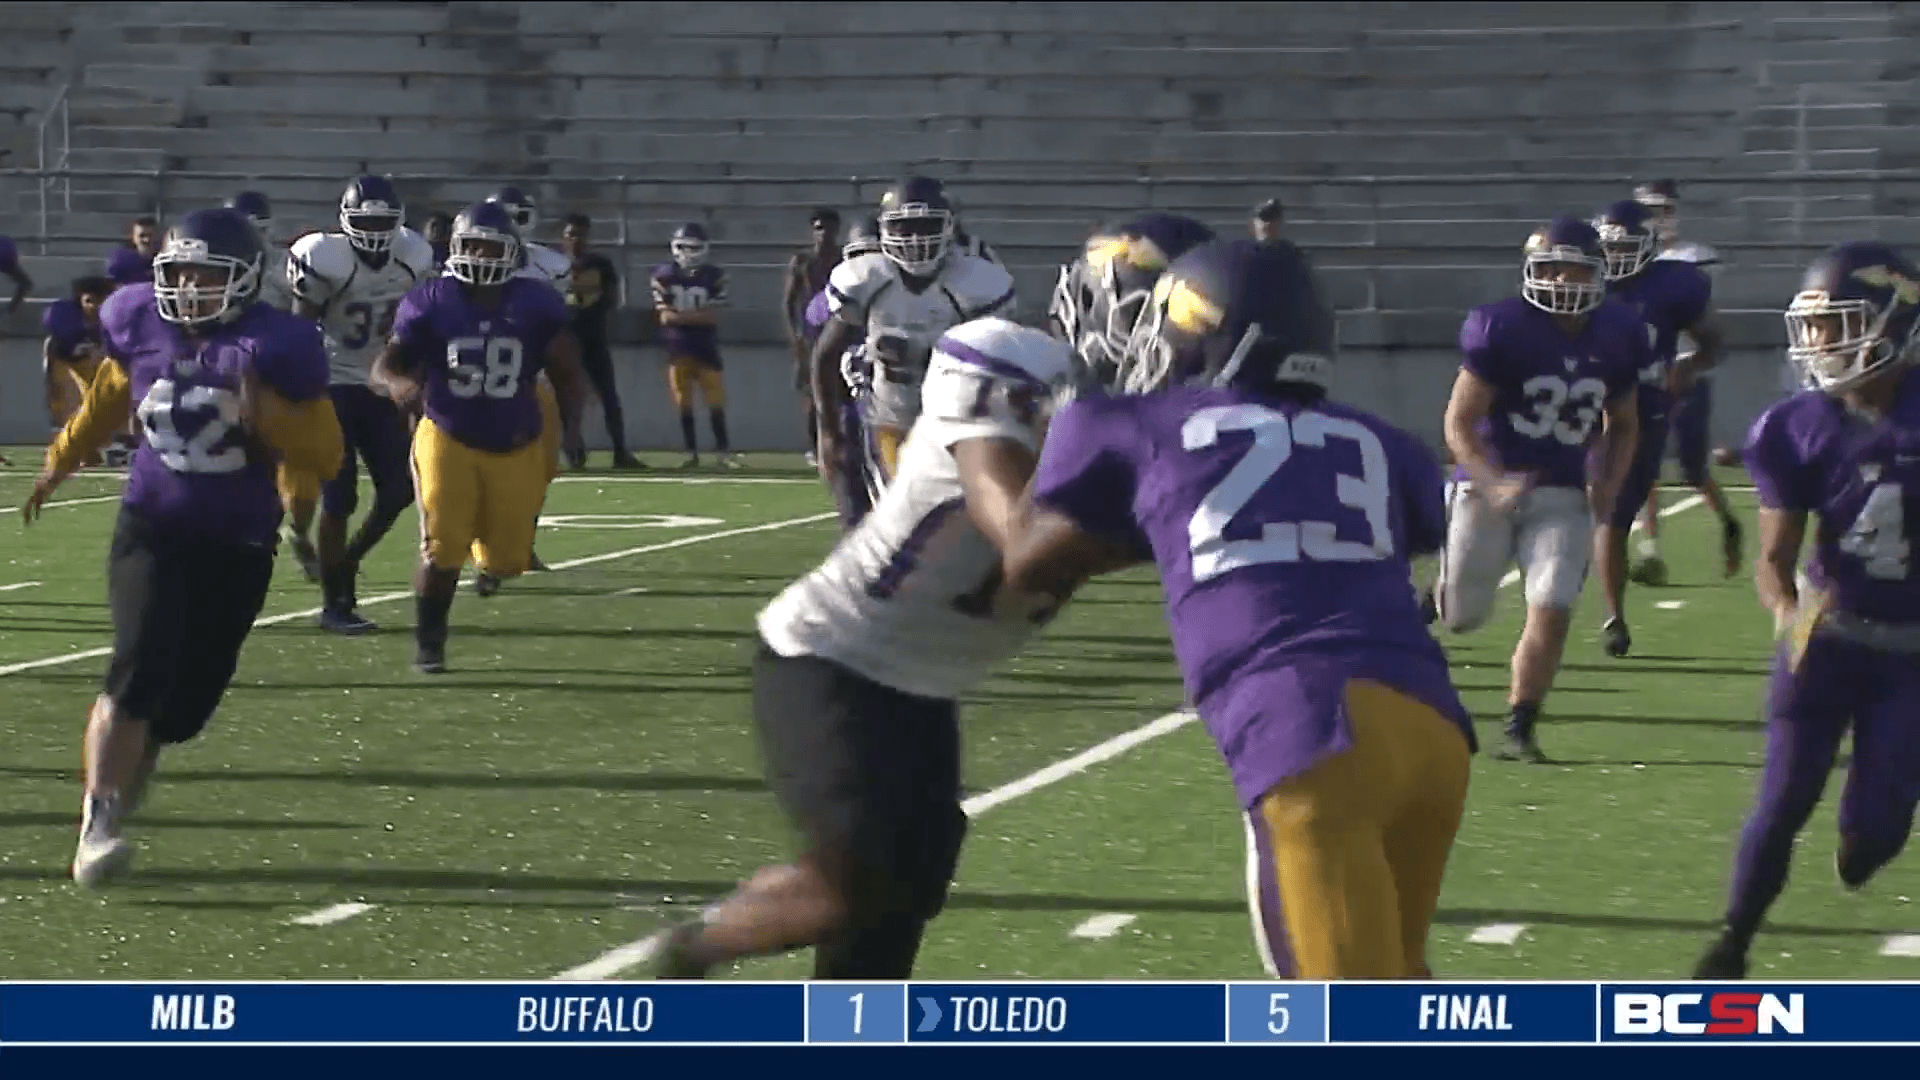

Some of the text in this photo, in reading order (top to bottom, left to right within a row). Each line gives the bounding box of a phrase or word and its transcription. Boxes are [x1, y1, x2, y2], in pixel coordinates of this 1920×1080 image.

[447, 336, 523, 399] 58
[136, 378, 247, 473] 42
[1509, 375, 1607, 445] 33
[1181, 403, 1395, 583] 23
